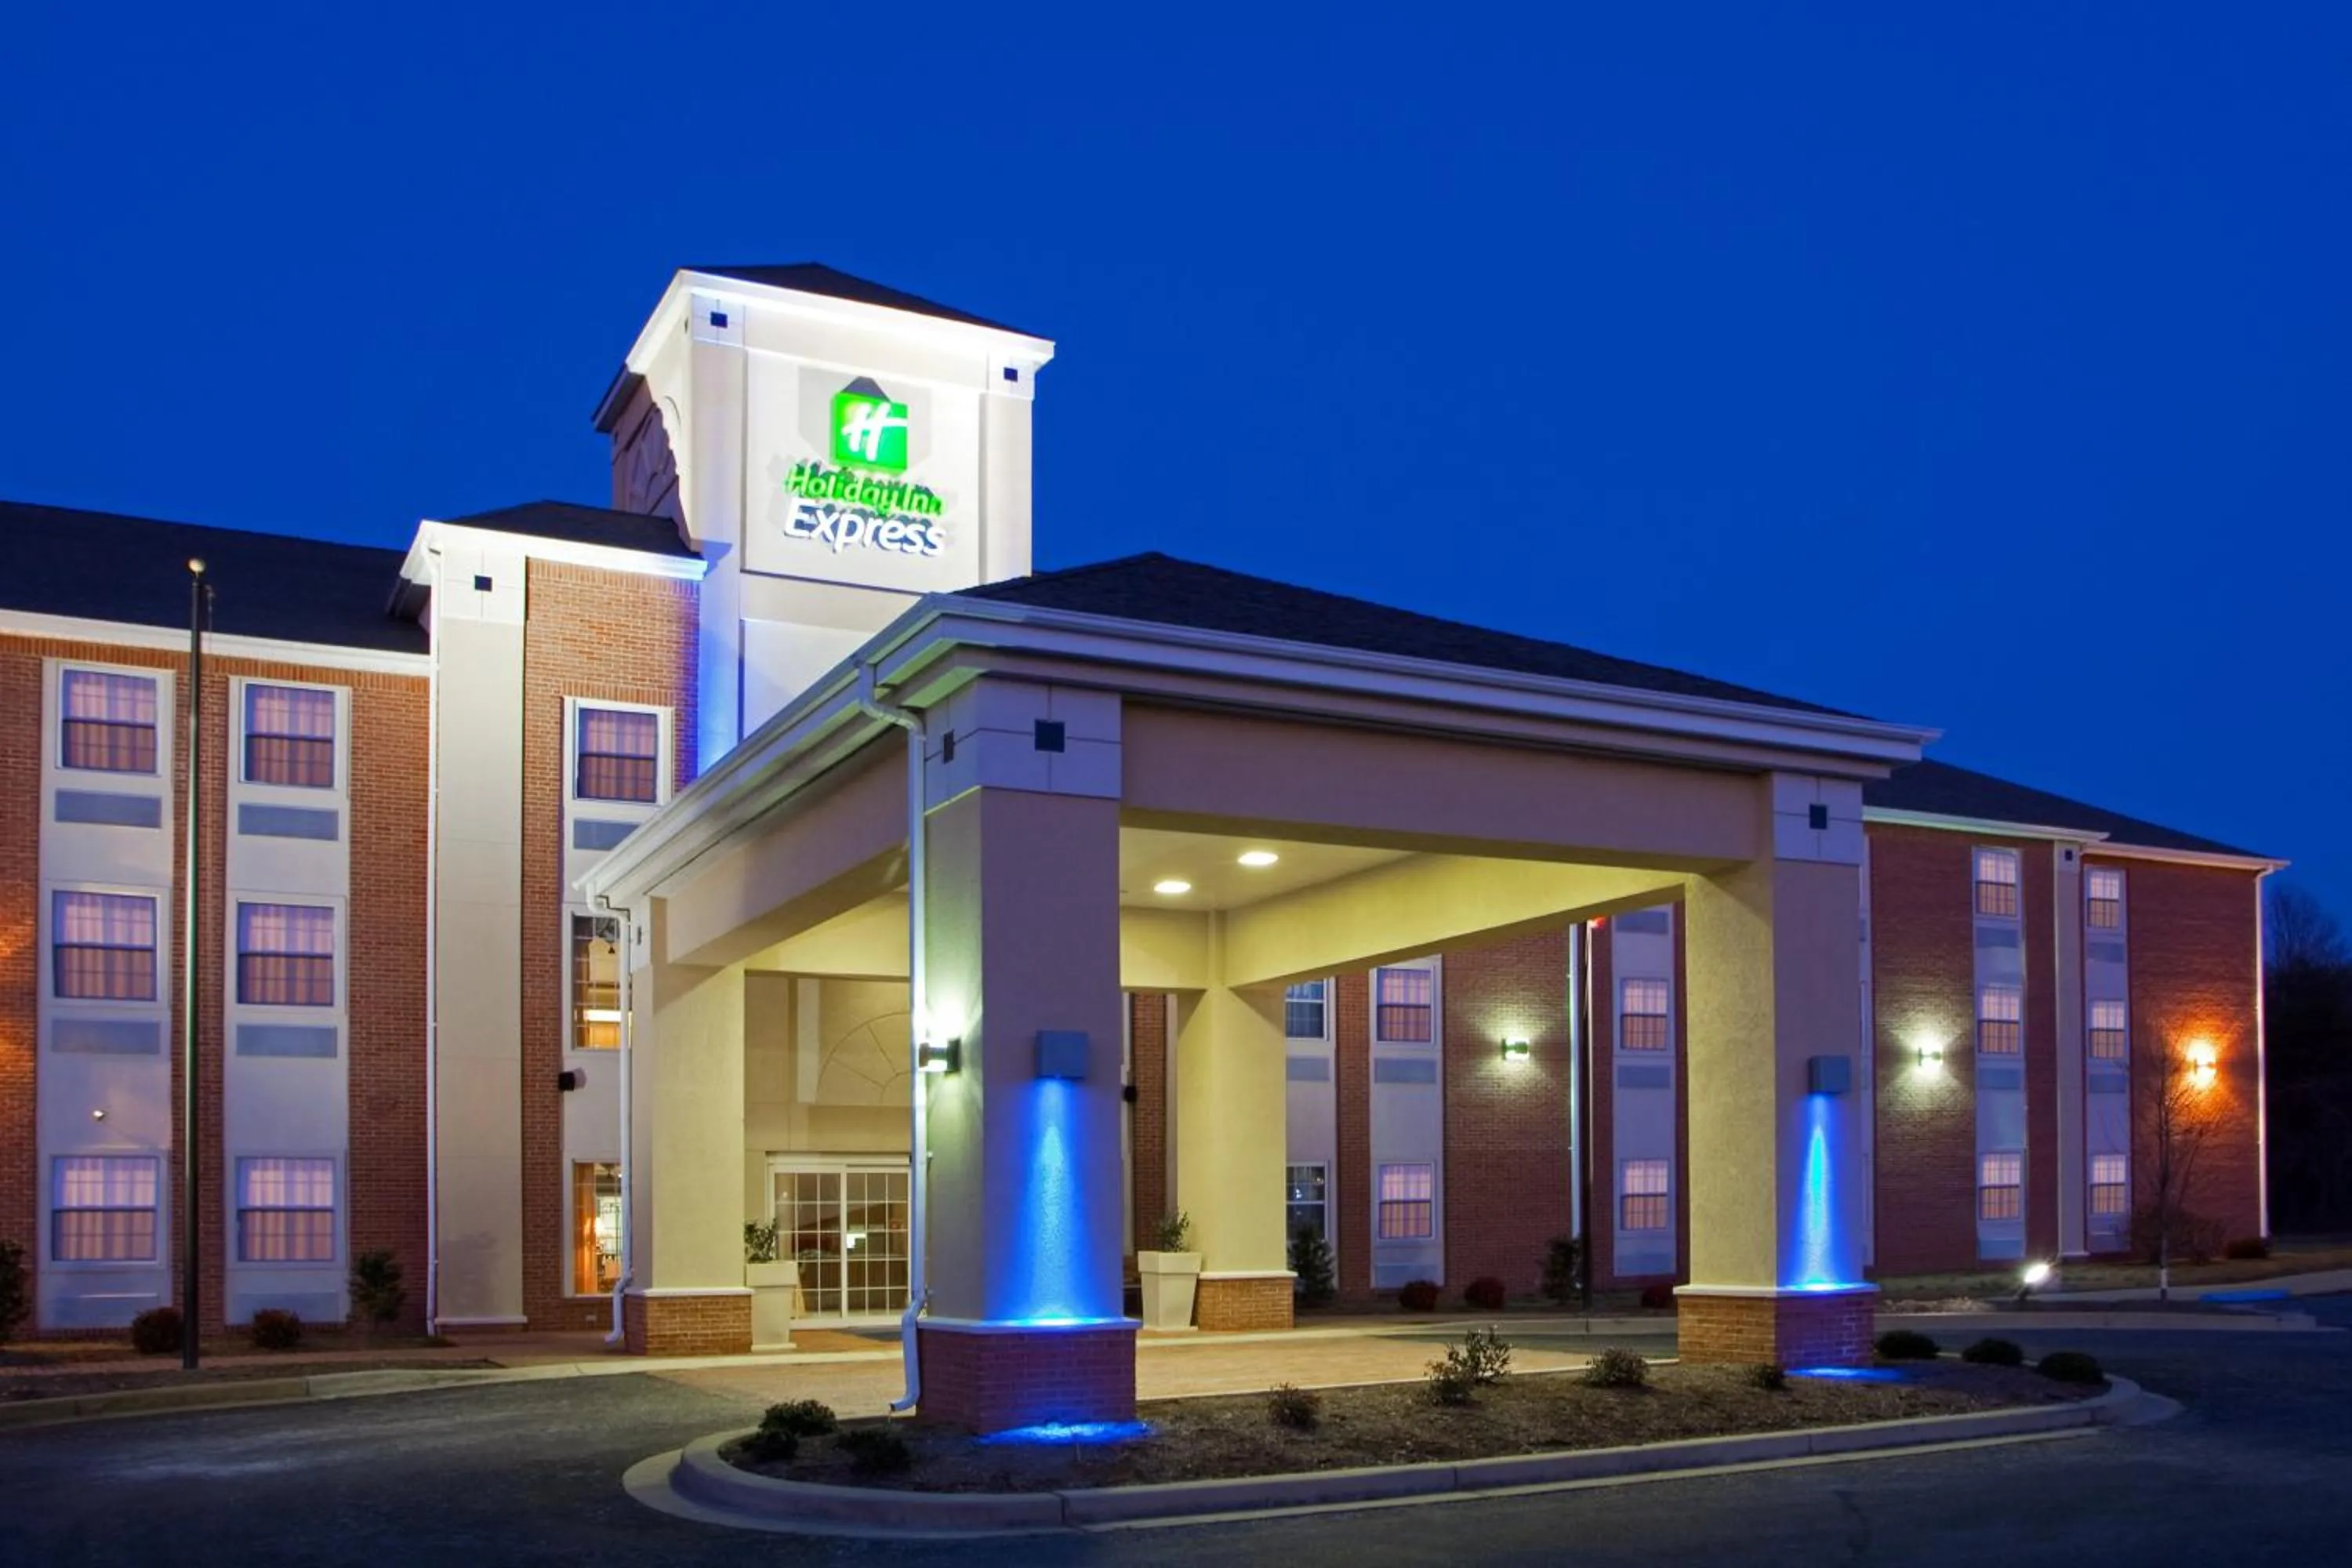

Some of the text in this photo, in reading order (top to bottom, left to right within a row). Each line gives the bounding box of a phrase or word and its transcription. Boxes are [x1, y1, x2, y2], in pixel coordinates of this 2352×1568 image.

[786, 464, 946, 515] Holiday Inn
[784, 498, 947, 556] Express
